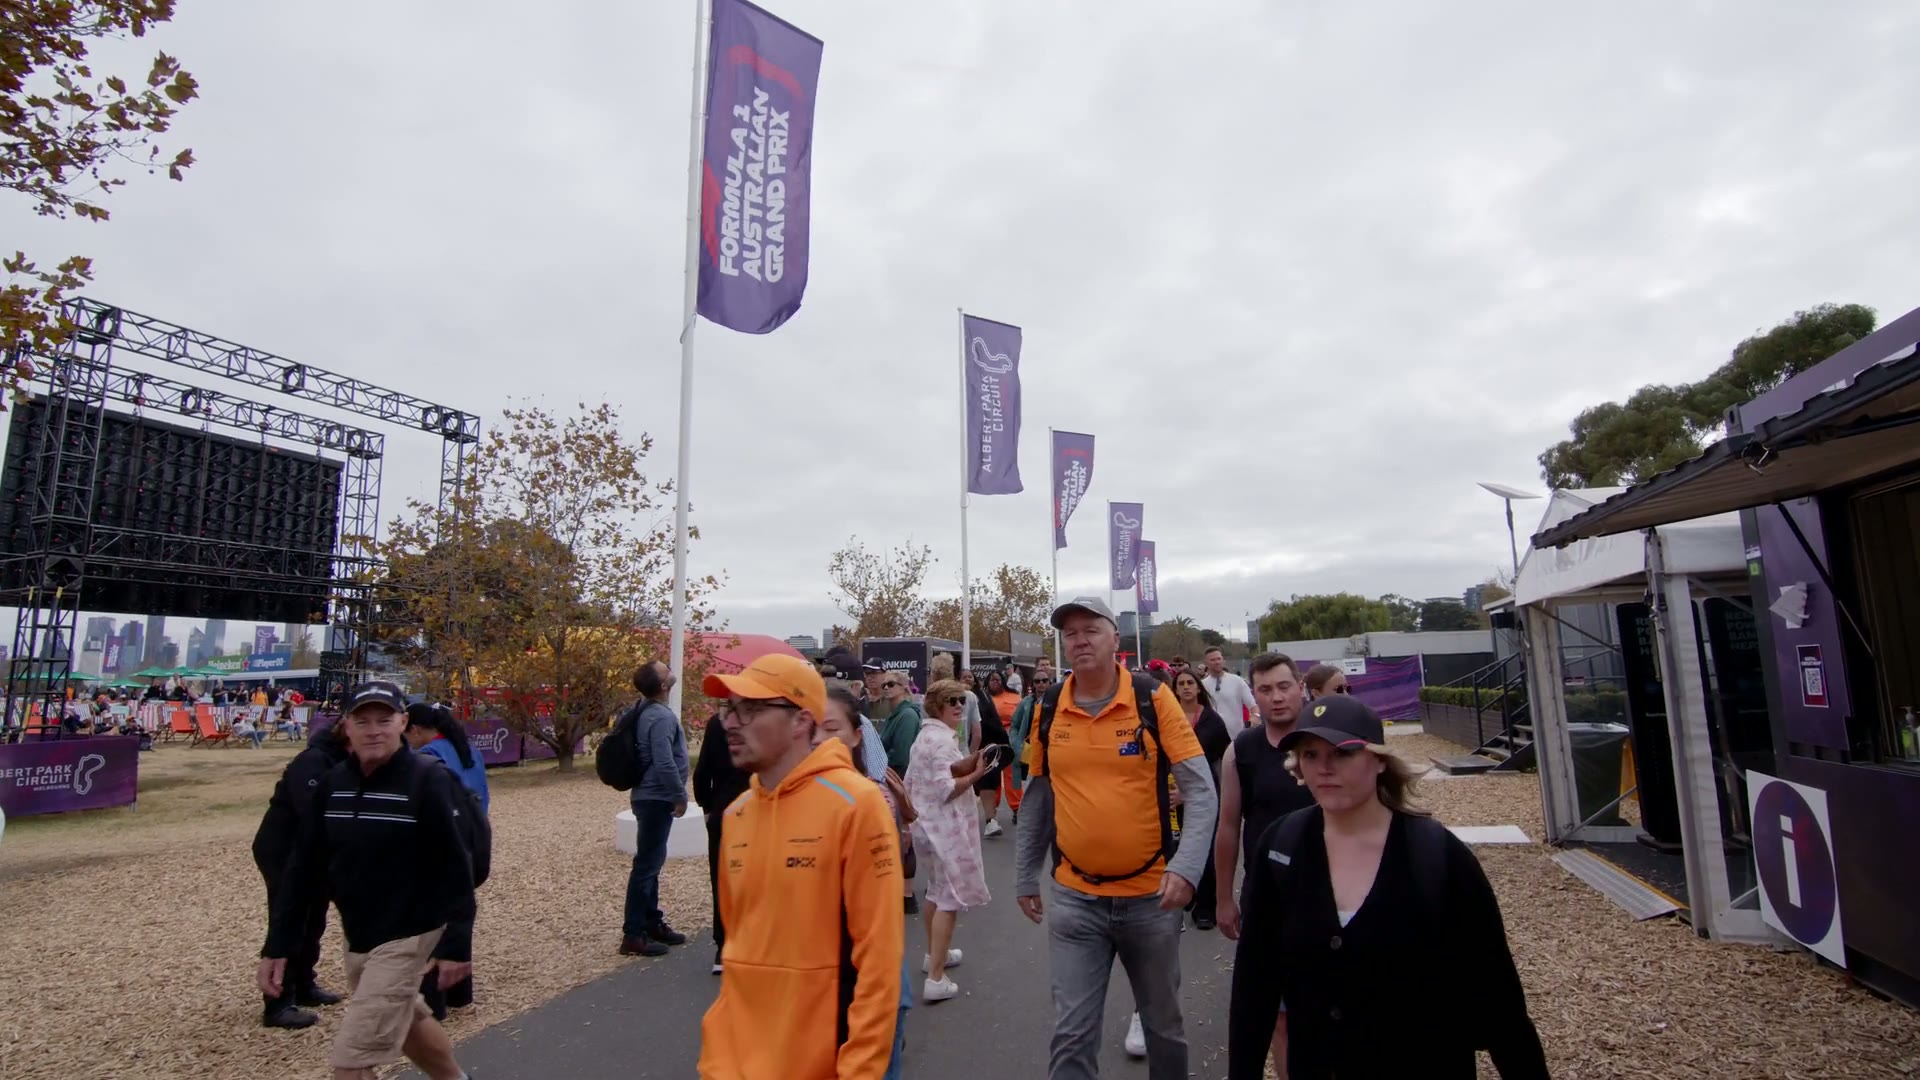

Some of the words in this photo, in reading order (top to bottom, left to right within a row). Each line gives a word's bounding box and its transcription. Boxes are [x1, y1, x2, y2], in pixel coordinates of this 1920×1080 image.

[733, 104, 751, 123] 1
[768, 106, 790, 175] PRIX
[720, 127, 747, 277] FORMULA
[742, 86, 769, 281] AUSTRALIAN
[764, 178, 786, 283] GRAND
[981, 375, 992, 412] PARK
[990, 375, 1003, 432] CIRCUIT
[982, 415, 992, 473] ALBERT
[208, 659, 241, 670] Heineken
[16, 773, 72, 787] CIRCUIT
[36, 764, 72, 775] PARK
